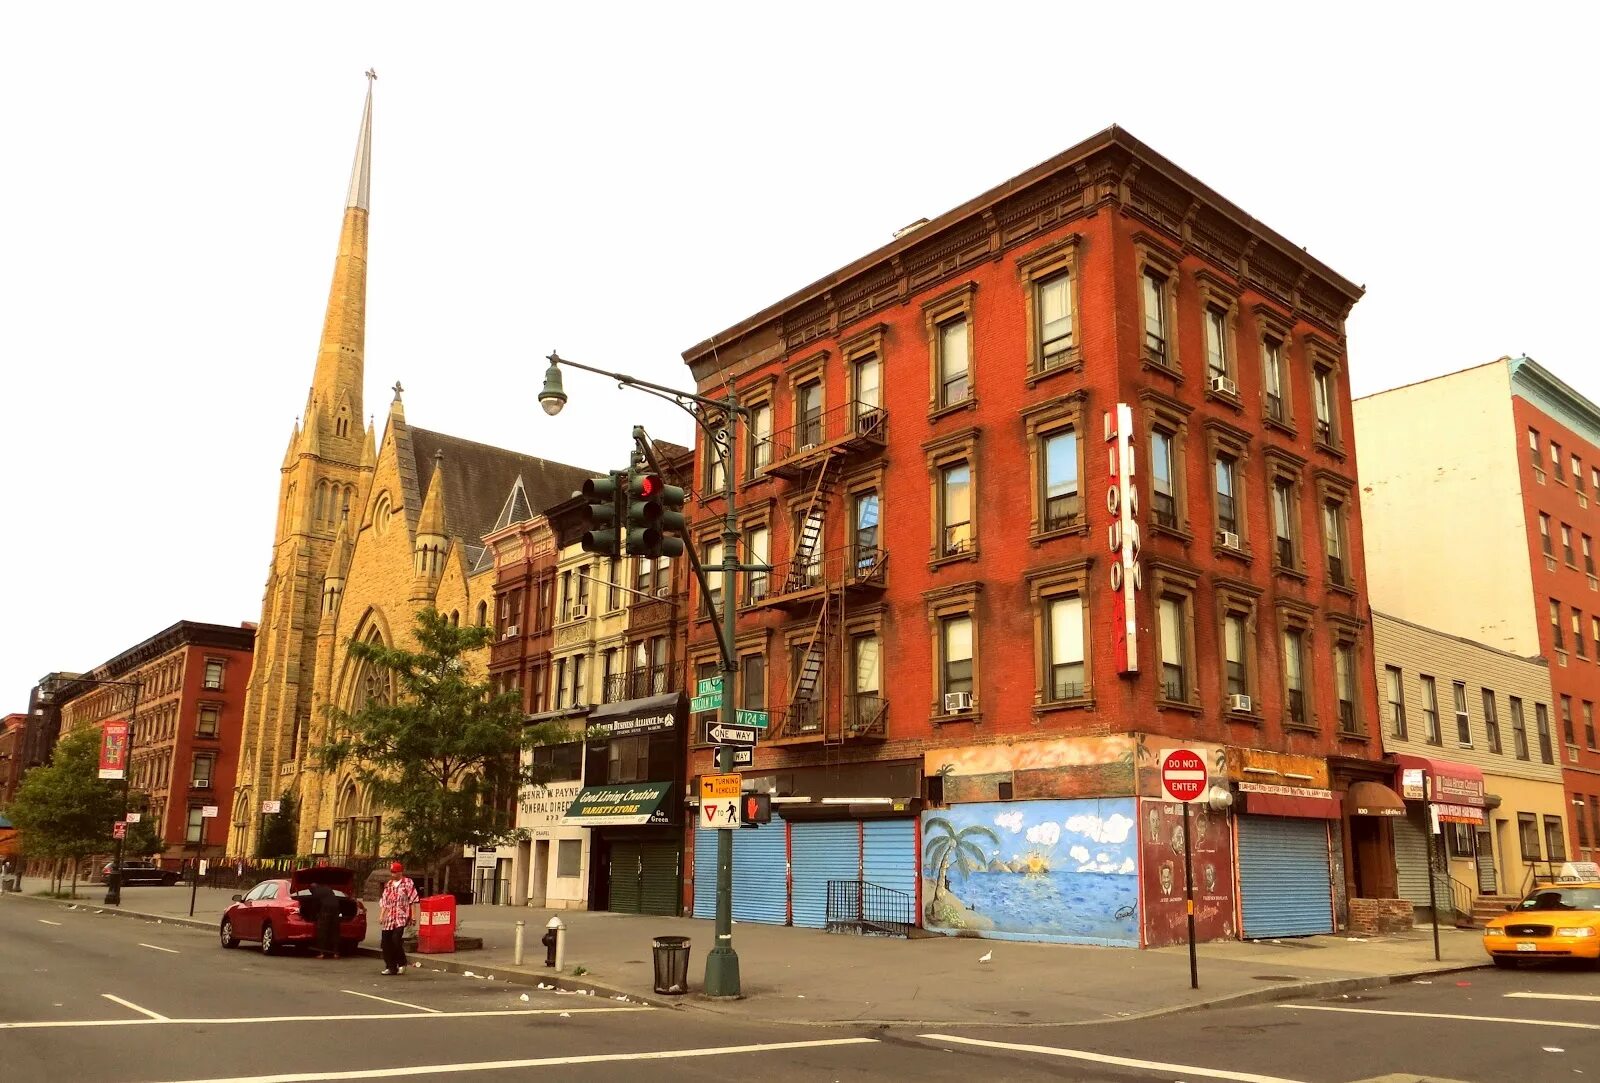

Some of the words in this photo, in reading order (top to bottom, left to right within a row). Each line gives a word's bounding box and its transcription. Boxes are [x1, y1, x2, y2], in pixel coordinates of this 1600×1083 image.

[736, 711, 743, 723] W
[744, 712, 757, 725] 124
[714, 729, 729, 739] ONE
[735, 731, 751, 740] WAY
[735, 752, 748, 761] WAY
[1168, 759, 1180, 768] DO
[1182, 759, 1199, 768] NOT
[715, 777, 738, 785] TURNING
[1171, 782, 1198, 791] ENTER
[522, 790, 545, 800] HENRY
[555, 787, 579, 798] PAYNE
[580, 791, 598, 803] Good
[623, 788, 660, 801] Creation
[521, 802, 548, 814] FUNERAL
[581, 806, 613, 815] VARIETY
[612, 805, 640, 814] STORE
[655, 809, 665, 817] Go
[651, 815, 669, 823] Green
